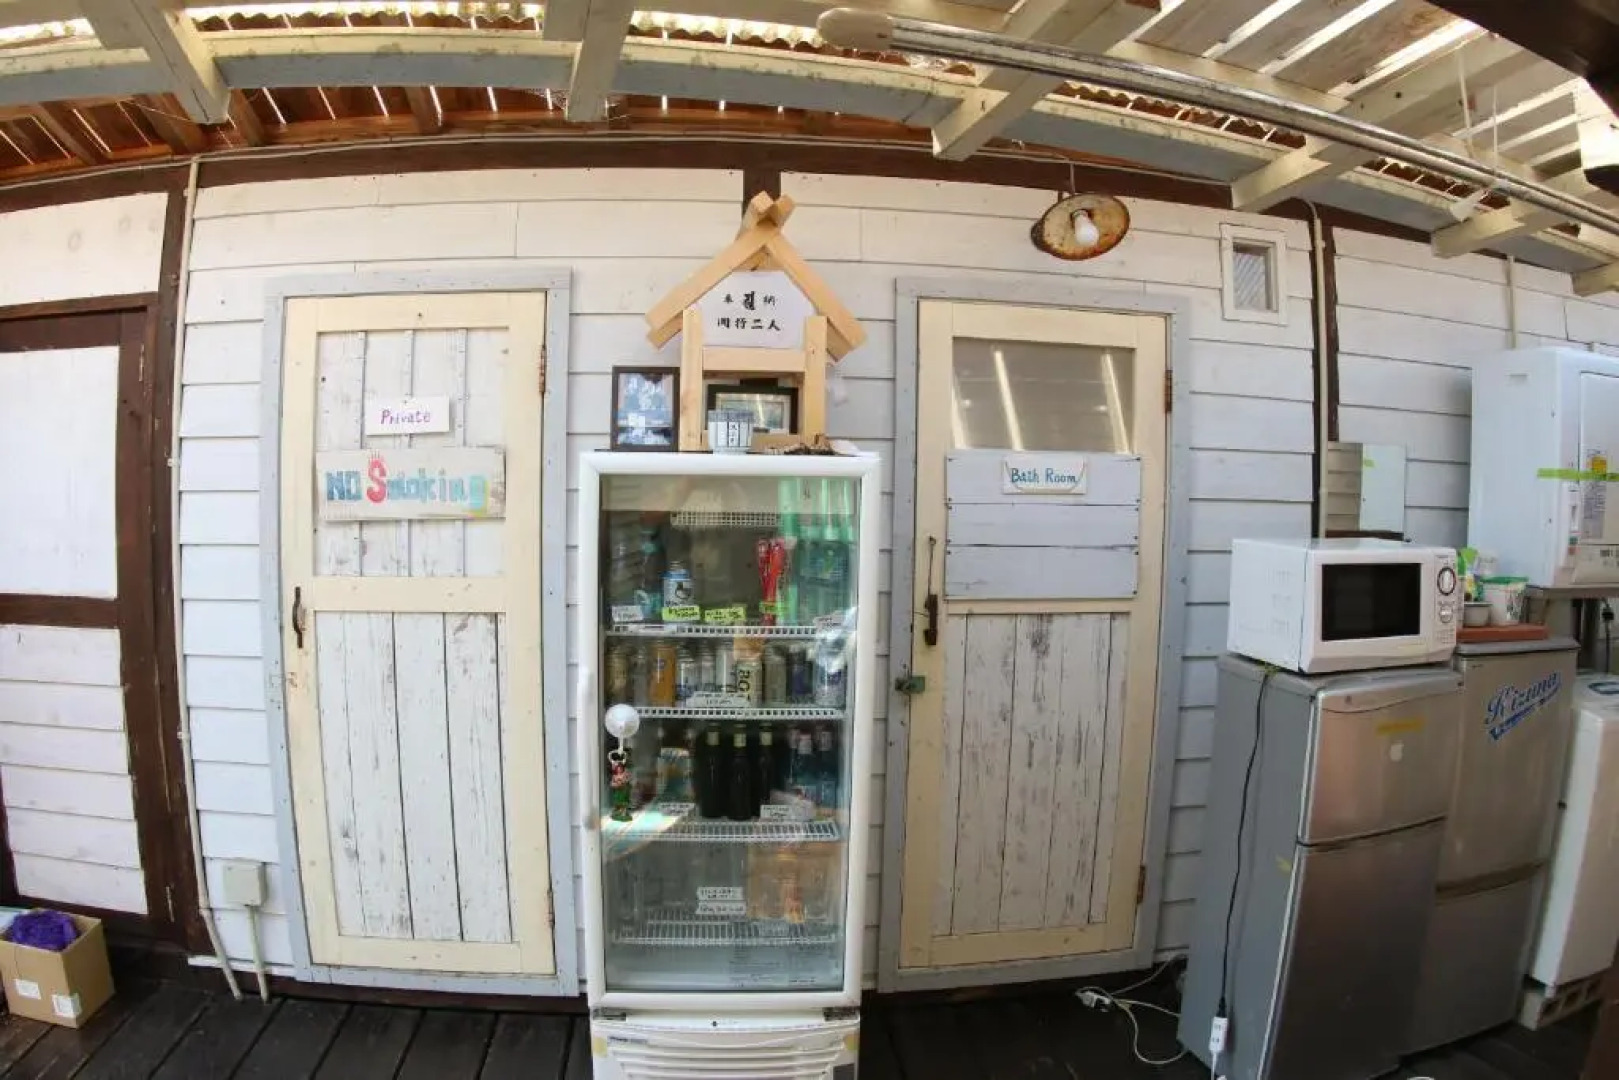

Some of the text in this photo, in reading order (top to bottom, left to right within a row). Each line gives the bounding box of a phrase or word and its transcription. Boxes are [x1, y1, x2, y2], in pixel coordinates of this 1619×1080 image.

[380, 408, 431, 425] Private
[326, 453, 489, 512] NO Smoking
[1010, 467, 1077, 484] Bath Room
[1484, 671, 1562, 726] Kizuna
